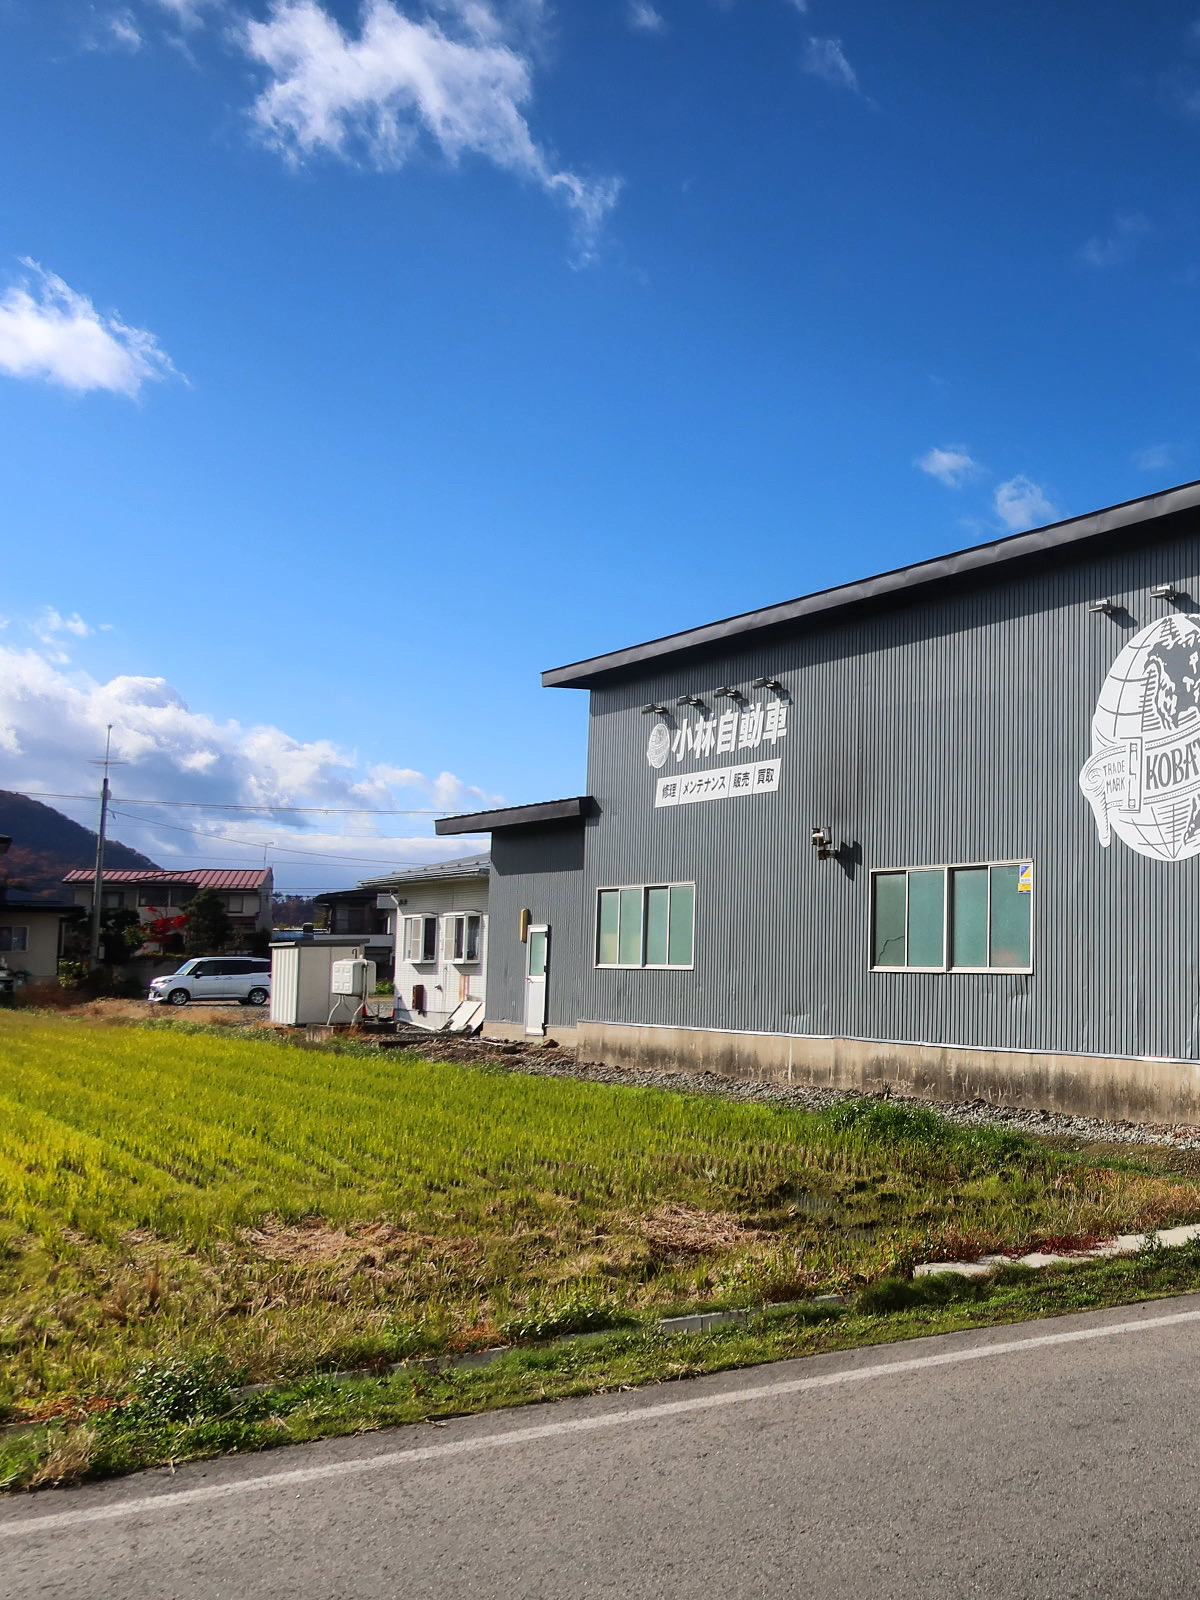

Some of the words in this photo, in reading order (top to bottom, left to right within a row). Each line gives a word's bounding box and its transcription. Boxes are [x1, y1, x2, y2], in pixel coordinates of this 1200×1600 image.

[671, 698, 788, 763] 小林自動車
[1103, 760, 1125, 777] TRADE
[662, 783, 677, 799] 修理
[683, 776, 726, 796] メンテナンス
[733, 771, 750, 788] 販売
[757, 768, 775, 785] 買取
[1106, 777, 1126, 795] MARK
